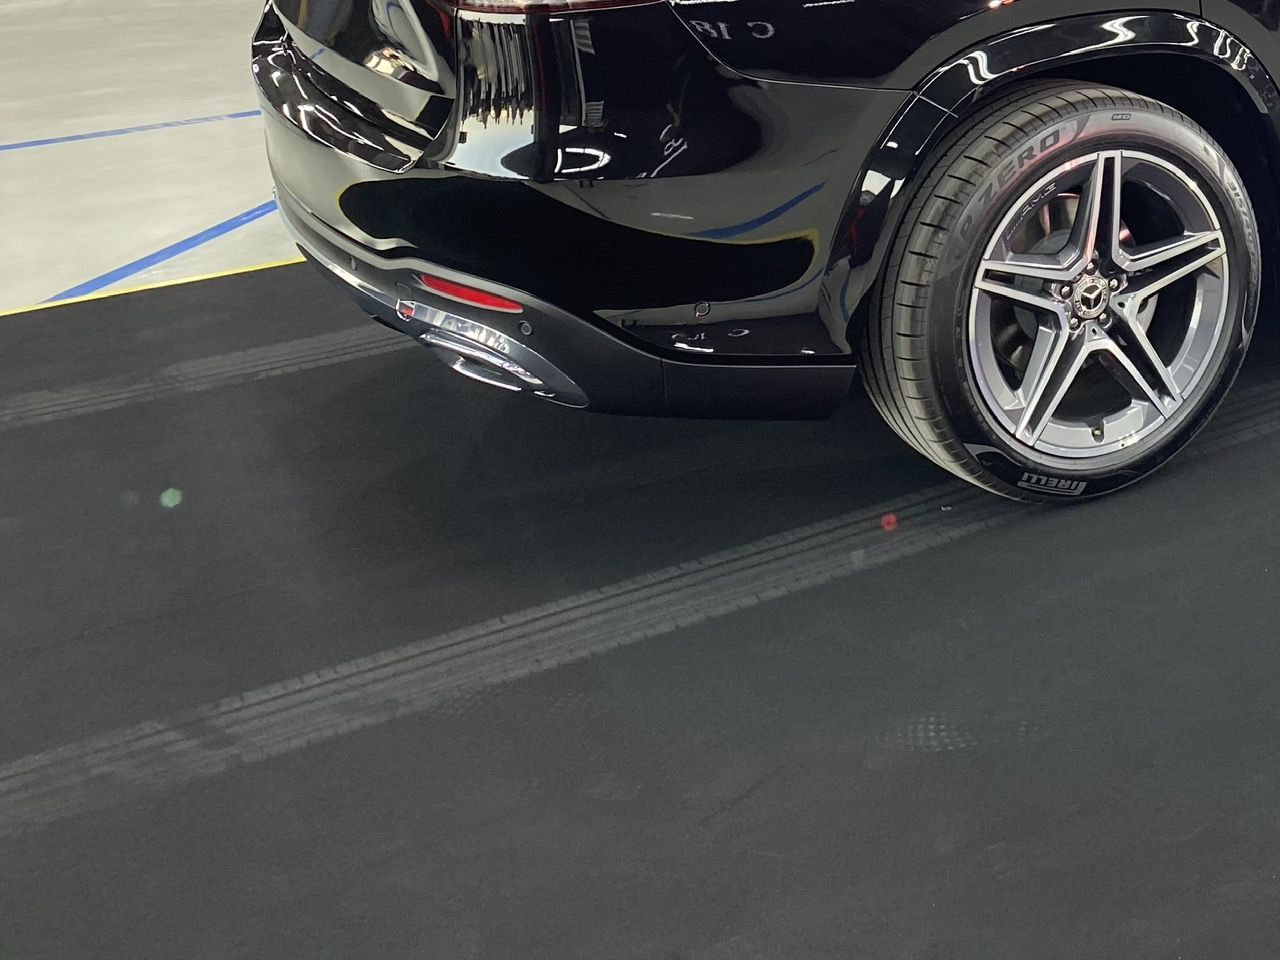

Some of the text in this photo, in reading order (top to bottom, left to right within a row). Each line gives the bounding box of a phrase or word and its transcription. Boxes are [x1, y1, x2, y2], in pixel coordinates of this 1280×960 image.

[960, 129, 1060, 240] P ZERO
[1017, 471, 1088, 496] PIRELLI
